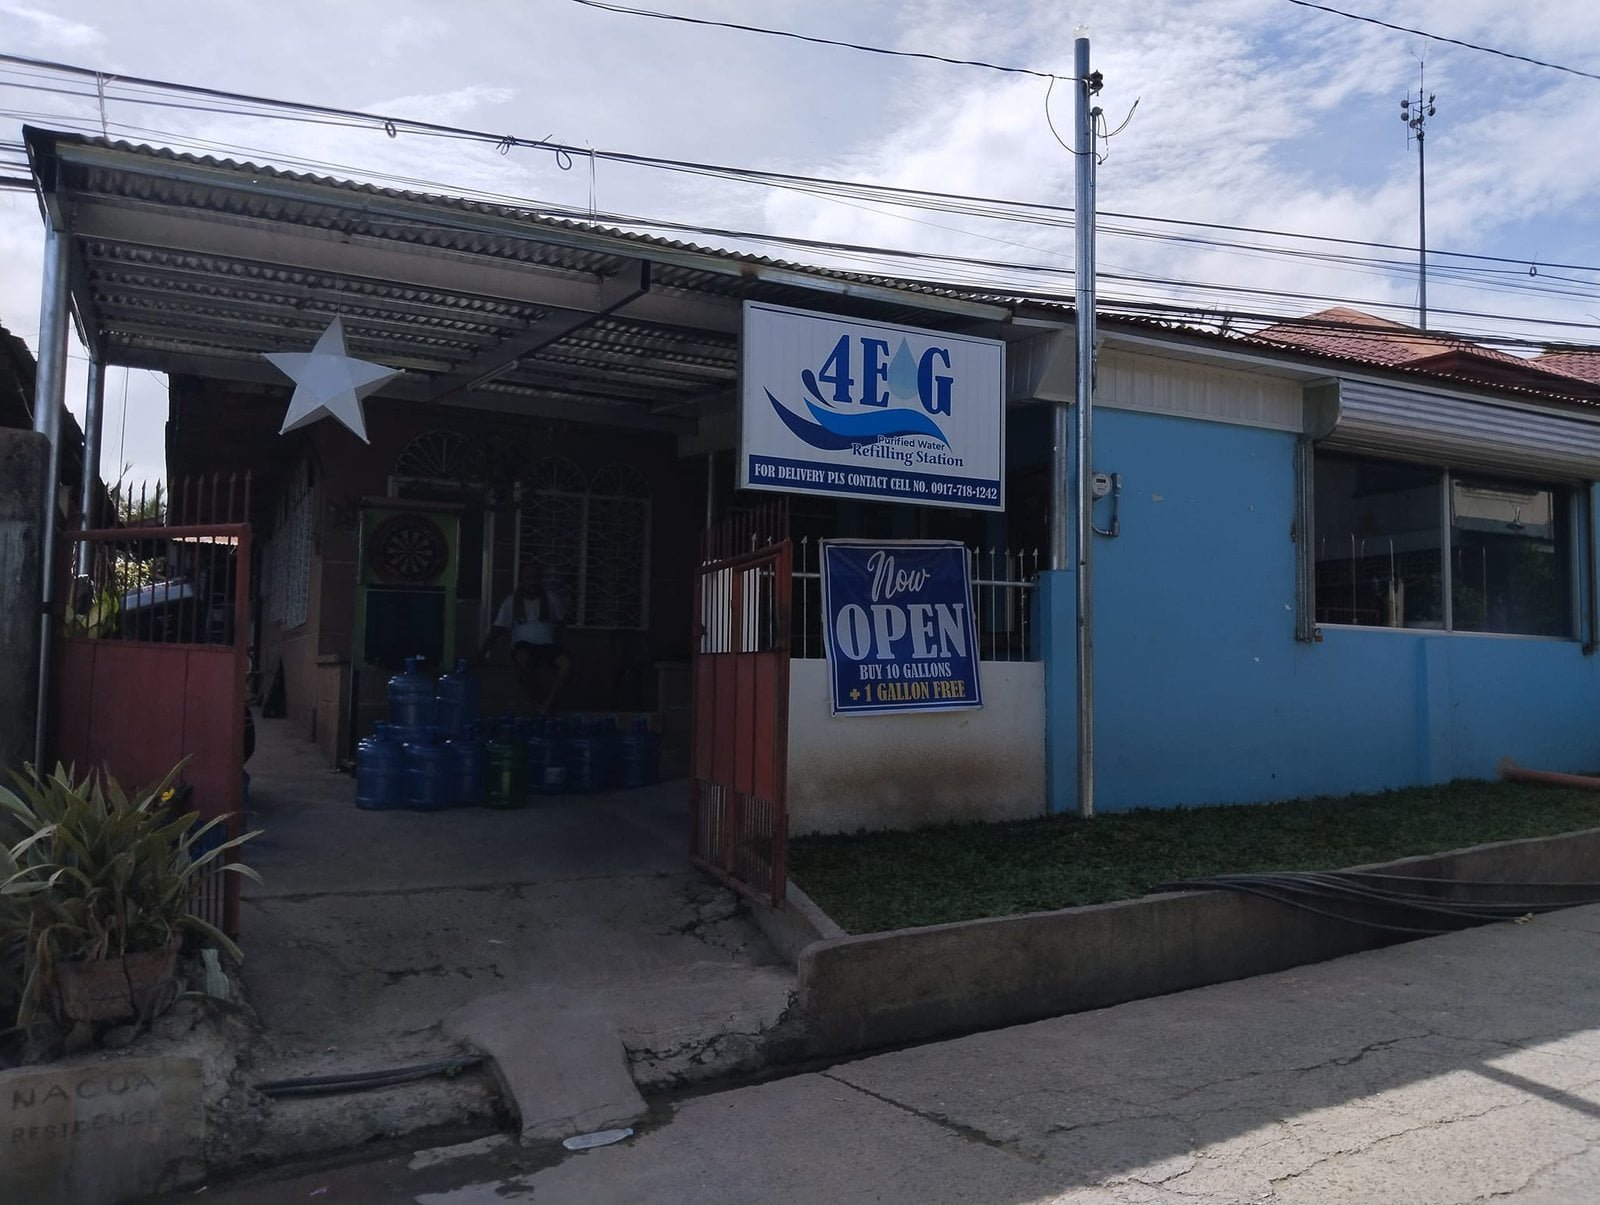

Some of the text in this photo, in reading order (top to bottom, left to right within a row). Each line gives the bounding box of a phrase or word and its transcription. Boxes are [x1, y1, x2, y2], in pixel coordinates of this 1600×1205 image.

[851, 443, 965, 467] Refilling Station
[877, 435, 946, 451] Purified Water
[754, 463, 998, 500] FOR DELIVERY PLS CONTACT CELL NO. 0917-718-1242
[867, 550, 931, 602] Now
[836, 603, 967, 660] OPEN
[859, 662, 952, 680] BUY 10 GALLONS
[864, 683, 872, 702] 1
[877, 681, 930, 701] GALLON
[933, 680, 966, 699] FREE
[12, 1073, 158, 1110] NACUA
